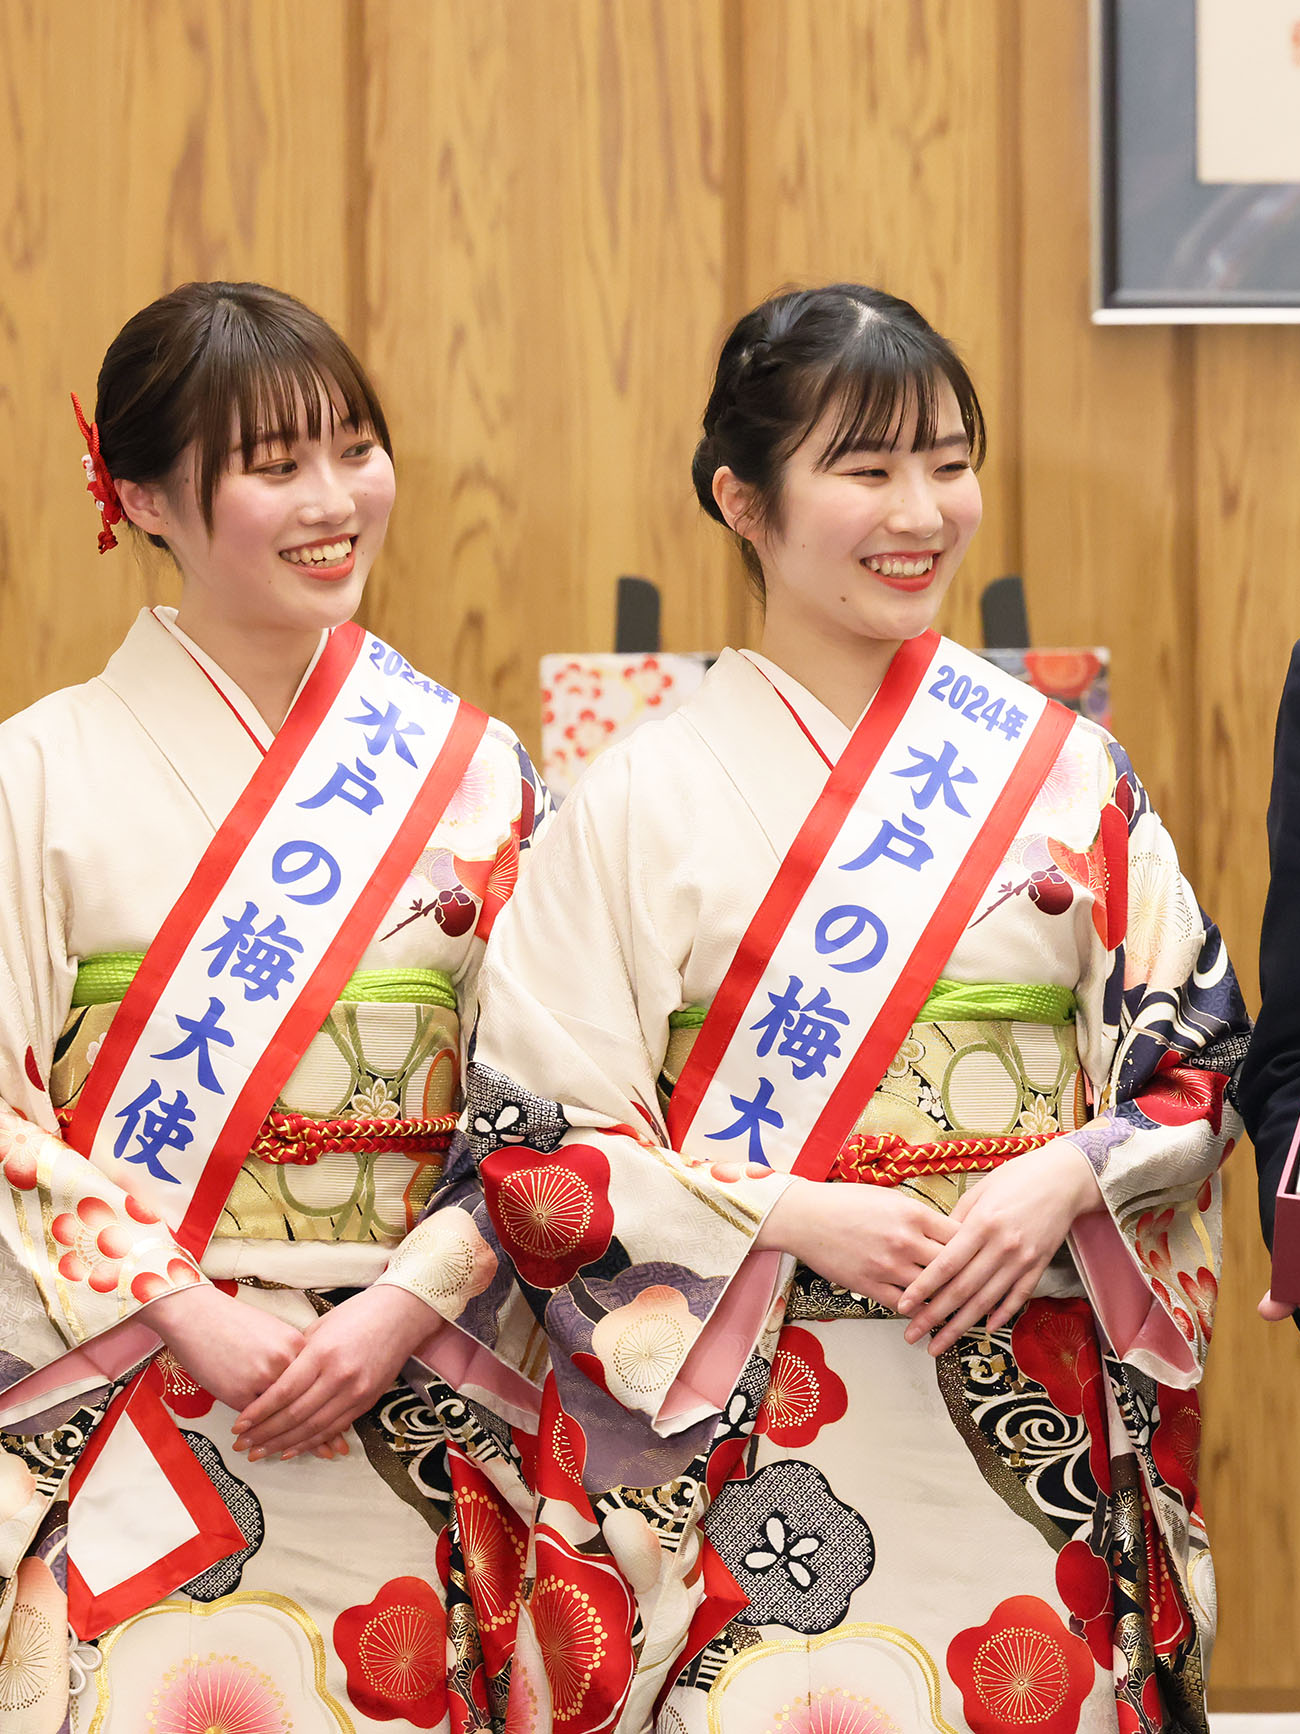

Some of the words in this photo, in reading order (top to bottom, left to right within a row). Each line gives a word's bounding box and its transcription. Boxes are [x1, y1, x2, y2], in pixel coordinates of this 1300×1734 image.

[368, 640, 455, 705] 2024年
[928, 664, 1029, 742] 2024年
[114, 695, 427, 1185] 水戸の梅大使
[704, 740, 979, 1168] 水戸の梅大
